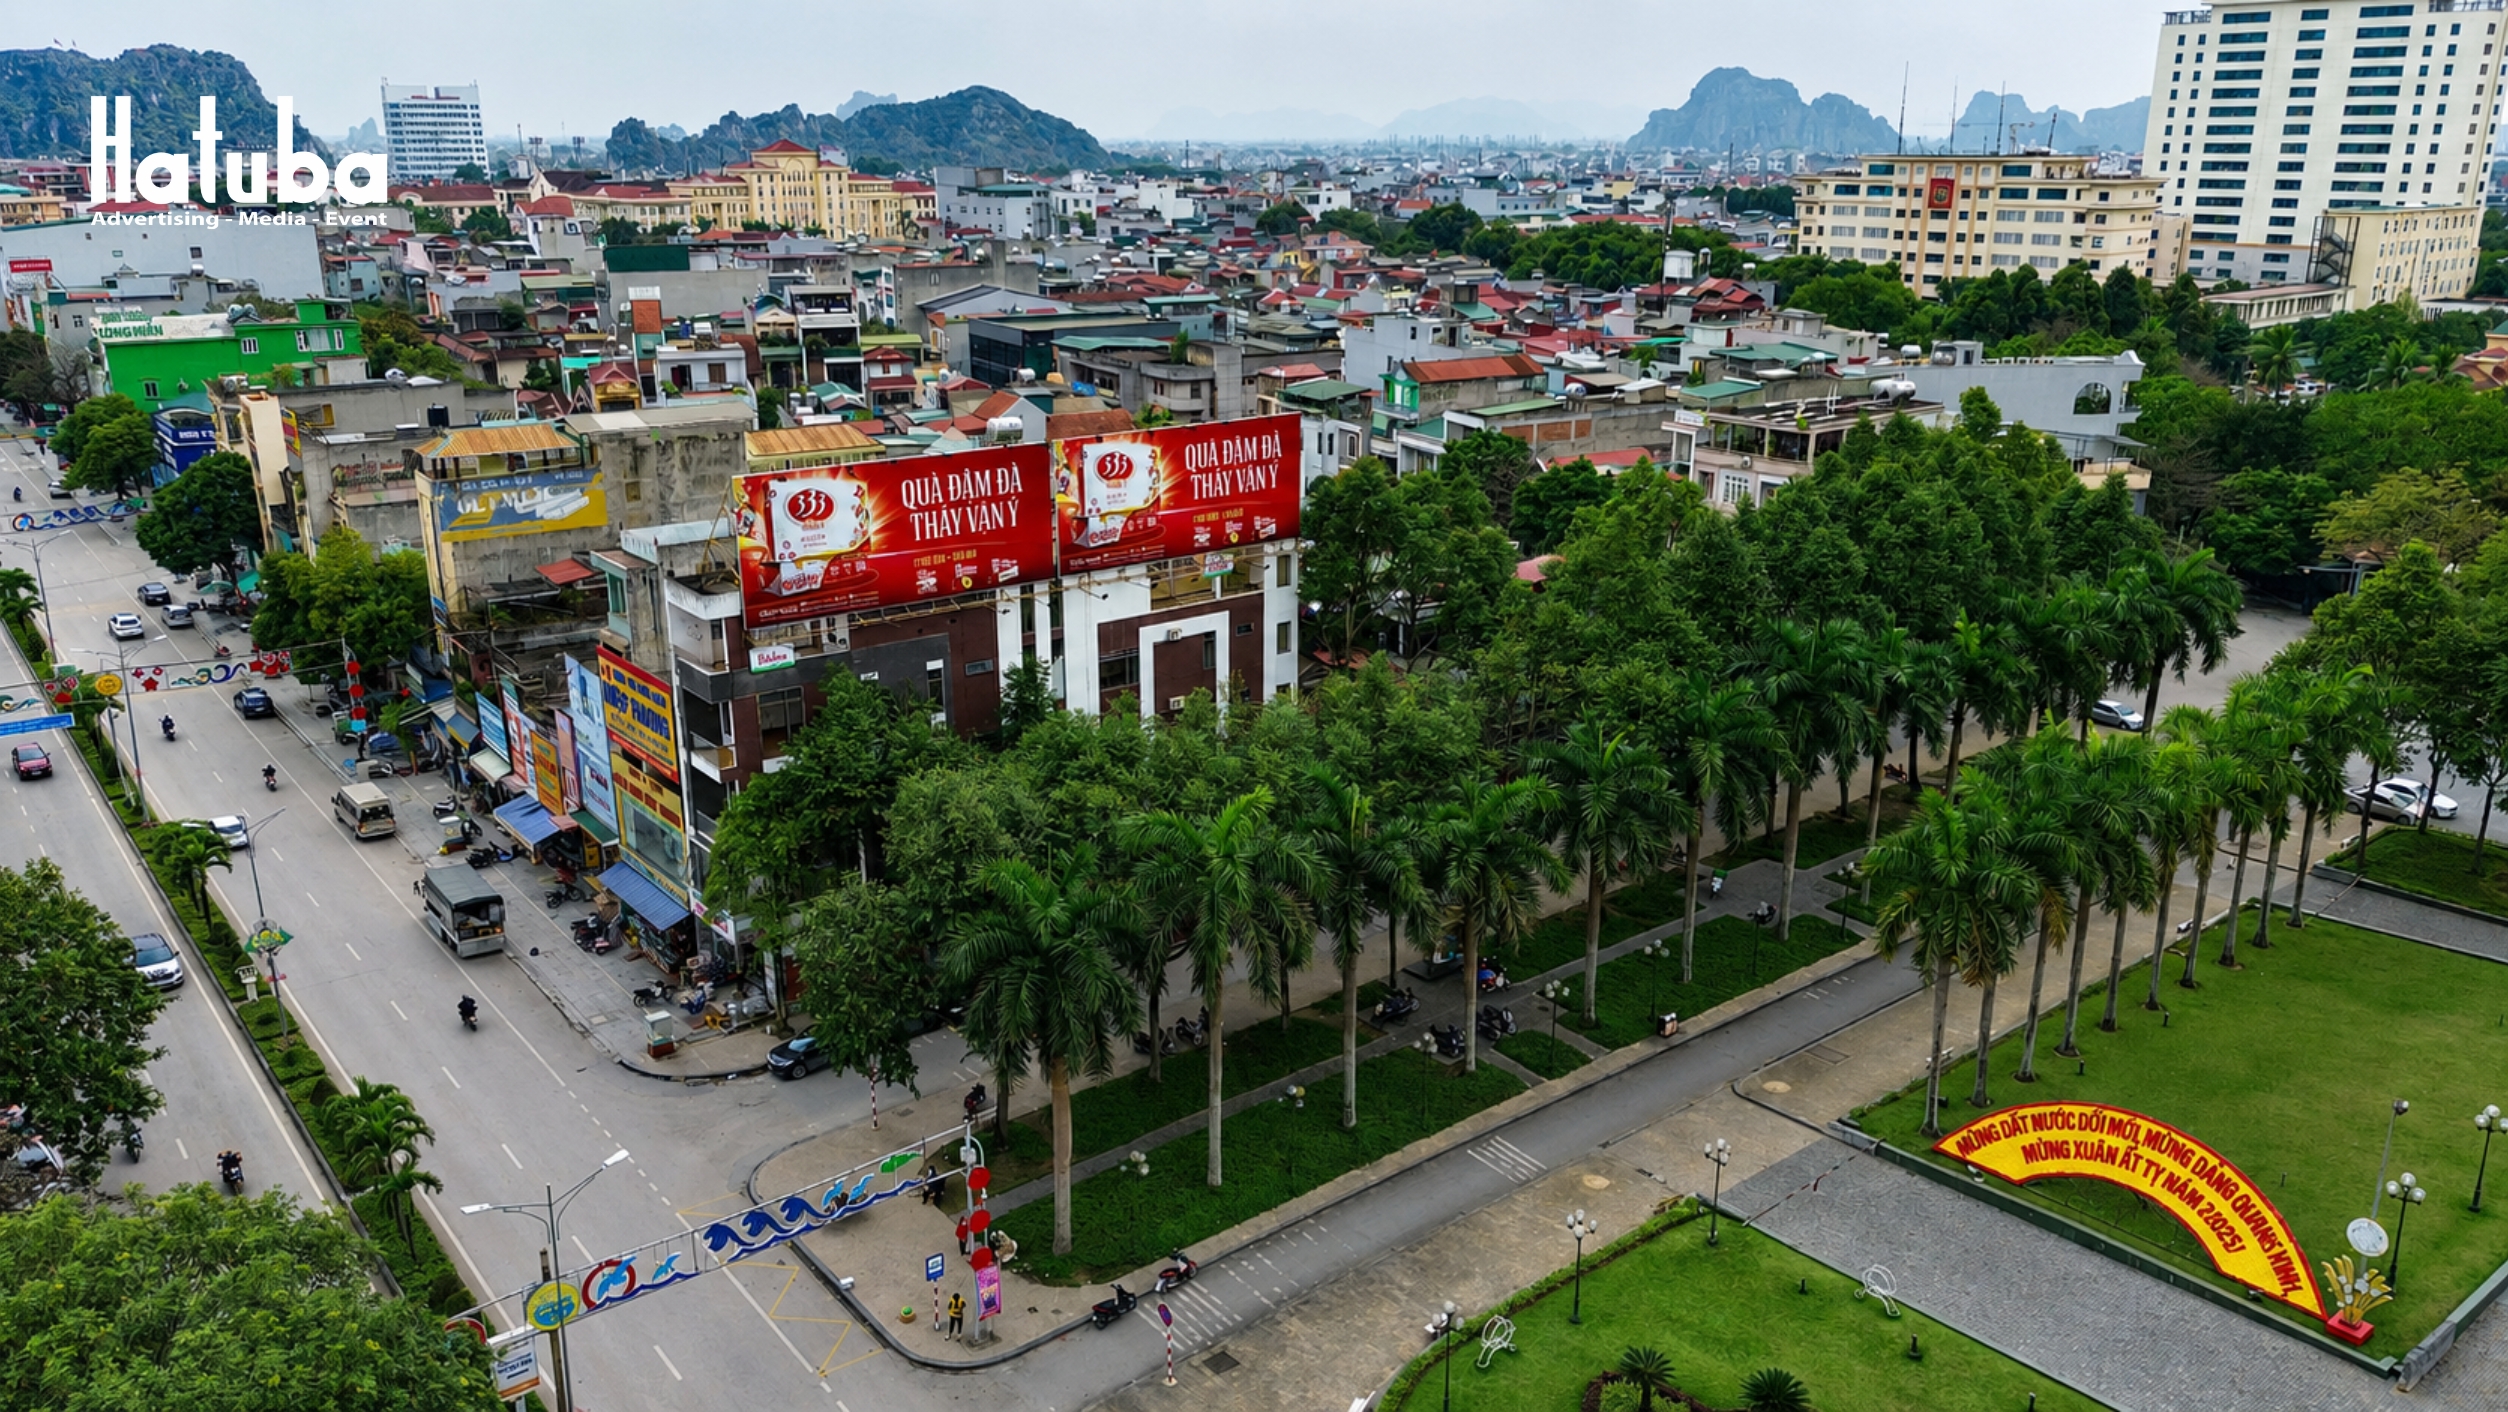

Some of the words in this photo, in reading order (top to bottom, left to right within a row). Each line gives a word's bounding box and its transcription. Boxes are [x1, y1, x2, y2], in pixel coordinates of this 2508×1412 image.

[901, 471, 943, 510] QUÀ
[996, 462, 1023, 495] ĐÀ
[796, 489, 826, 518] 333
[2030, 1107, 2075, 1132] NƯỚC
[2073, 1139, 2120, 1166] XUÂN
